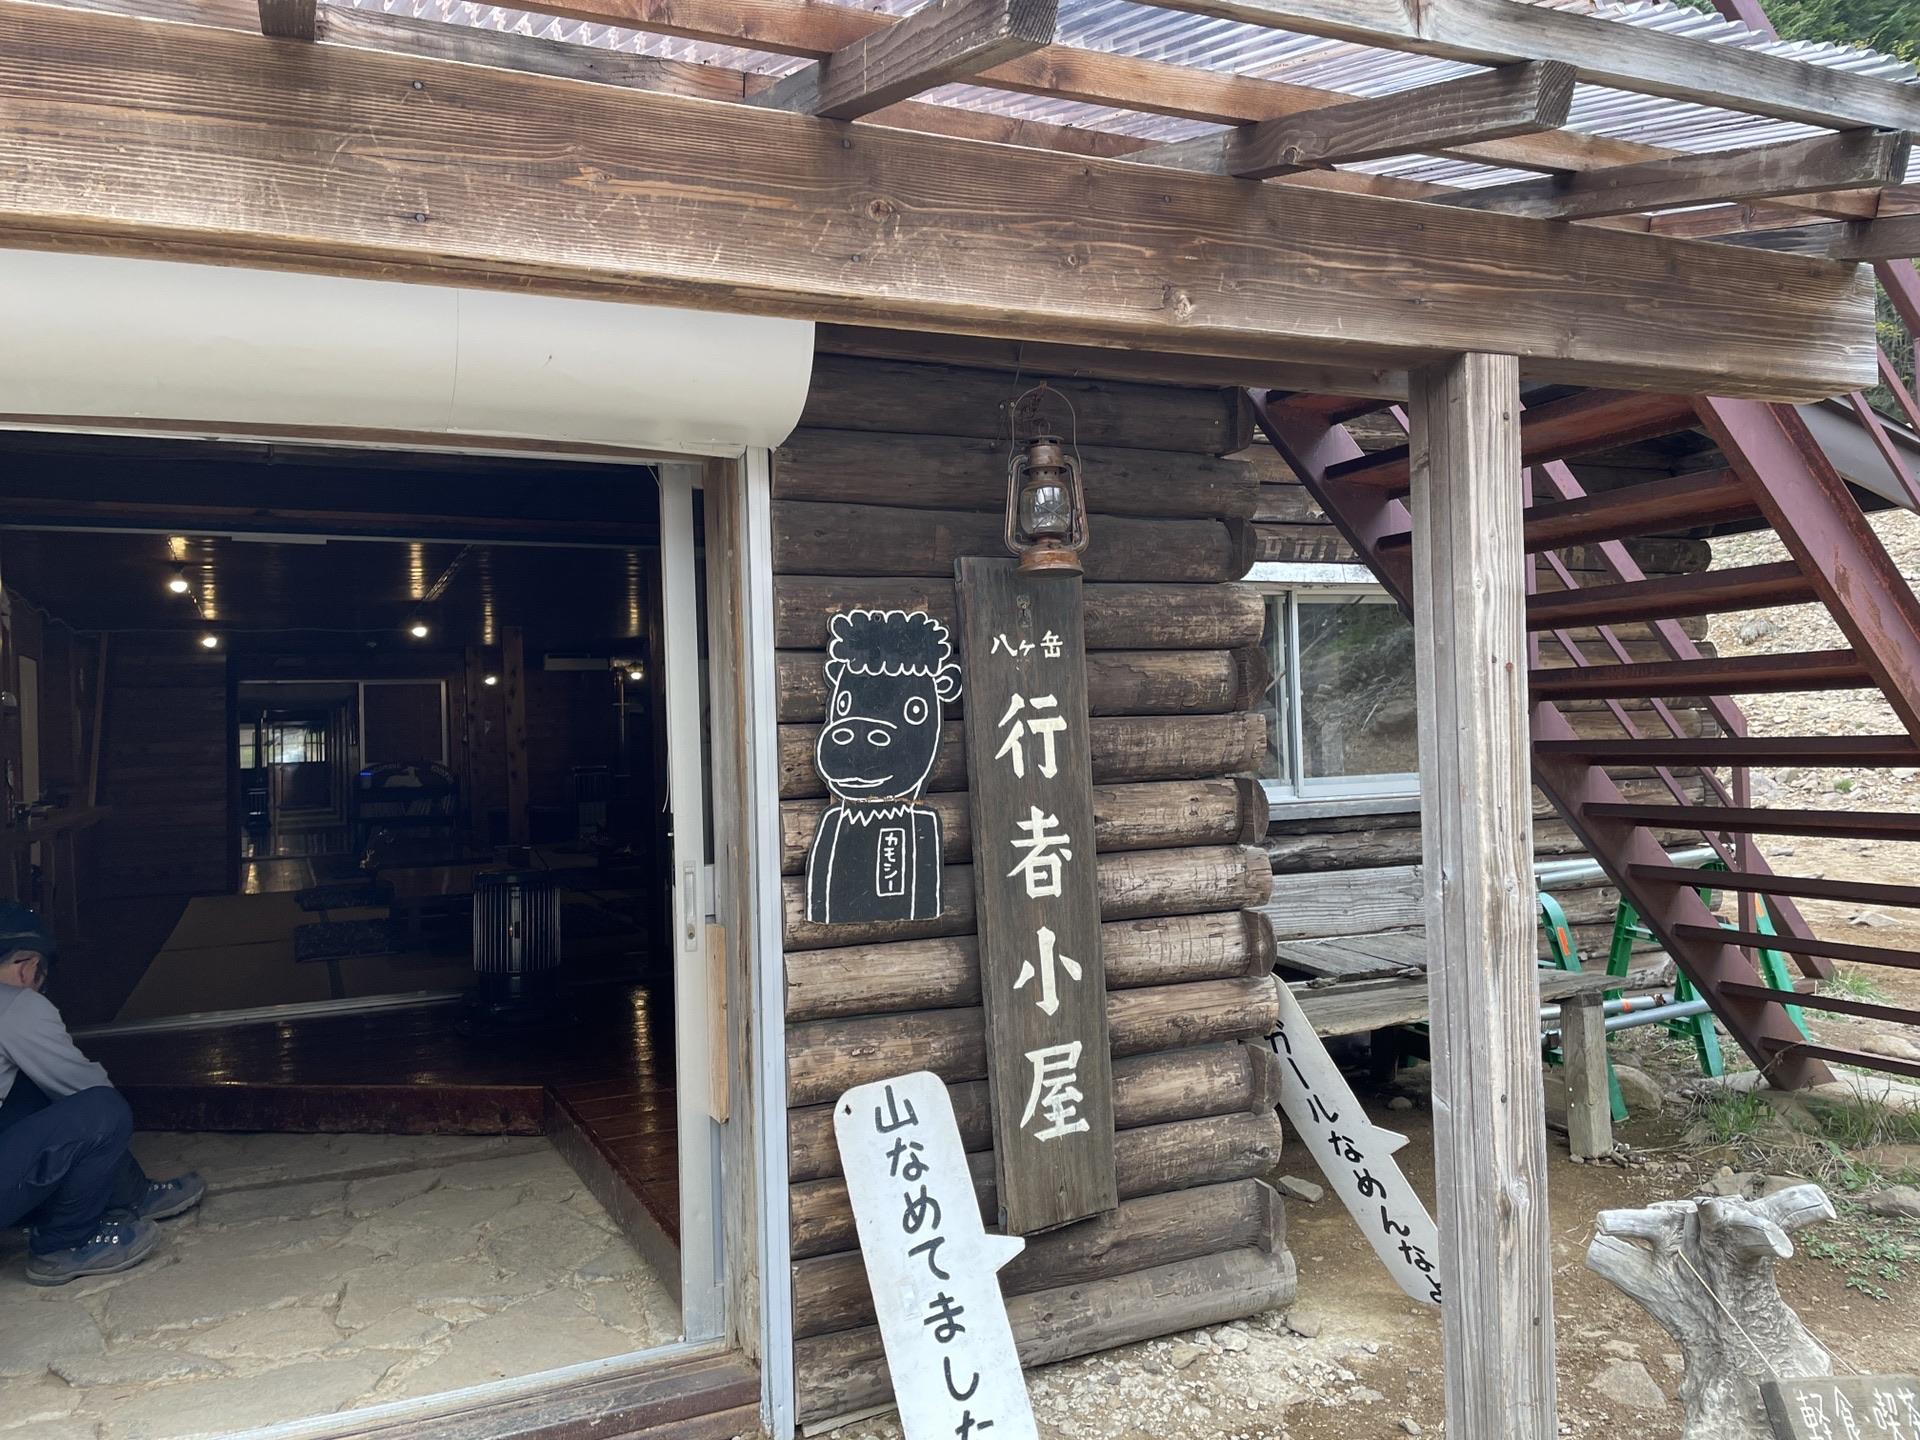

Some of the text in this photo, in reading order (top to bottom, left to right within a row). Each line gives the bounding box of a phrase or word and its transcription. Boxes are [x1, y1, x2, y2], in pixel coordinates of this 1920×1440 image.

[991, 630, 1063, 658] 八ヶ岳
[883, 832, 899, 891] カモシー
[994, 693, 1090, 1142] 行者小屋
[874, 1085, 994, 1440] 山なめてました
